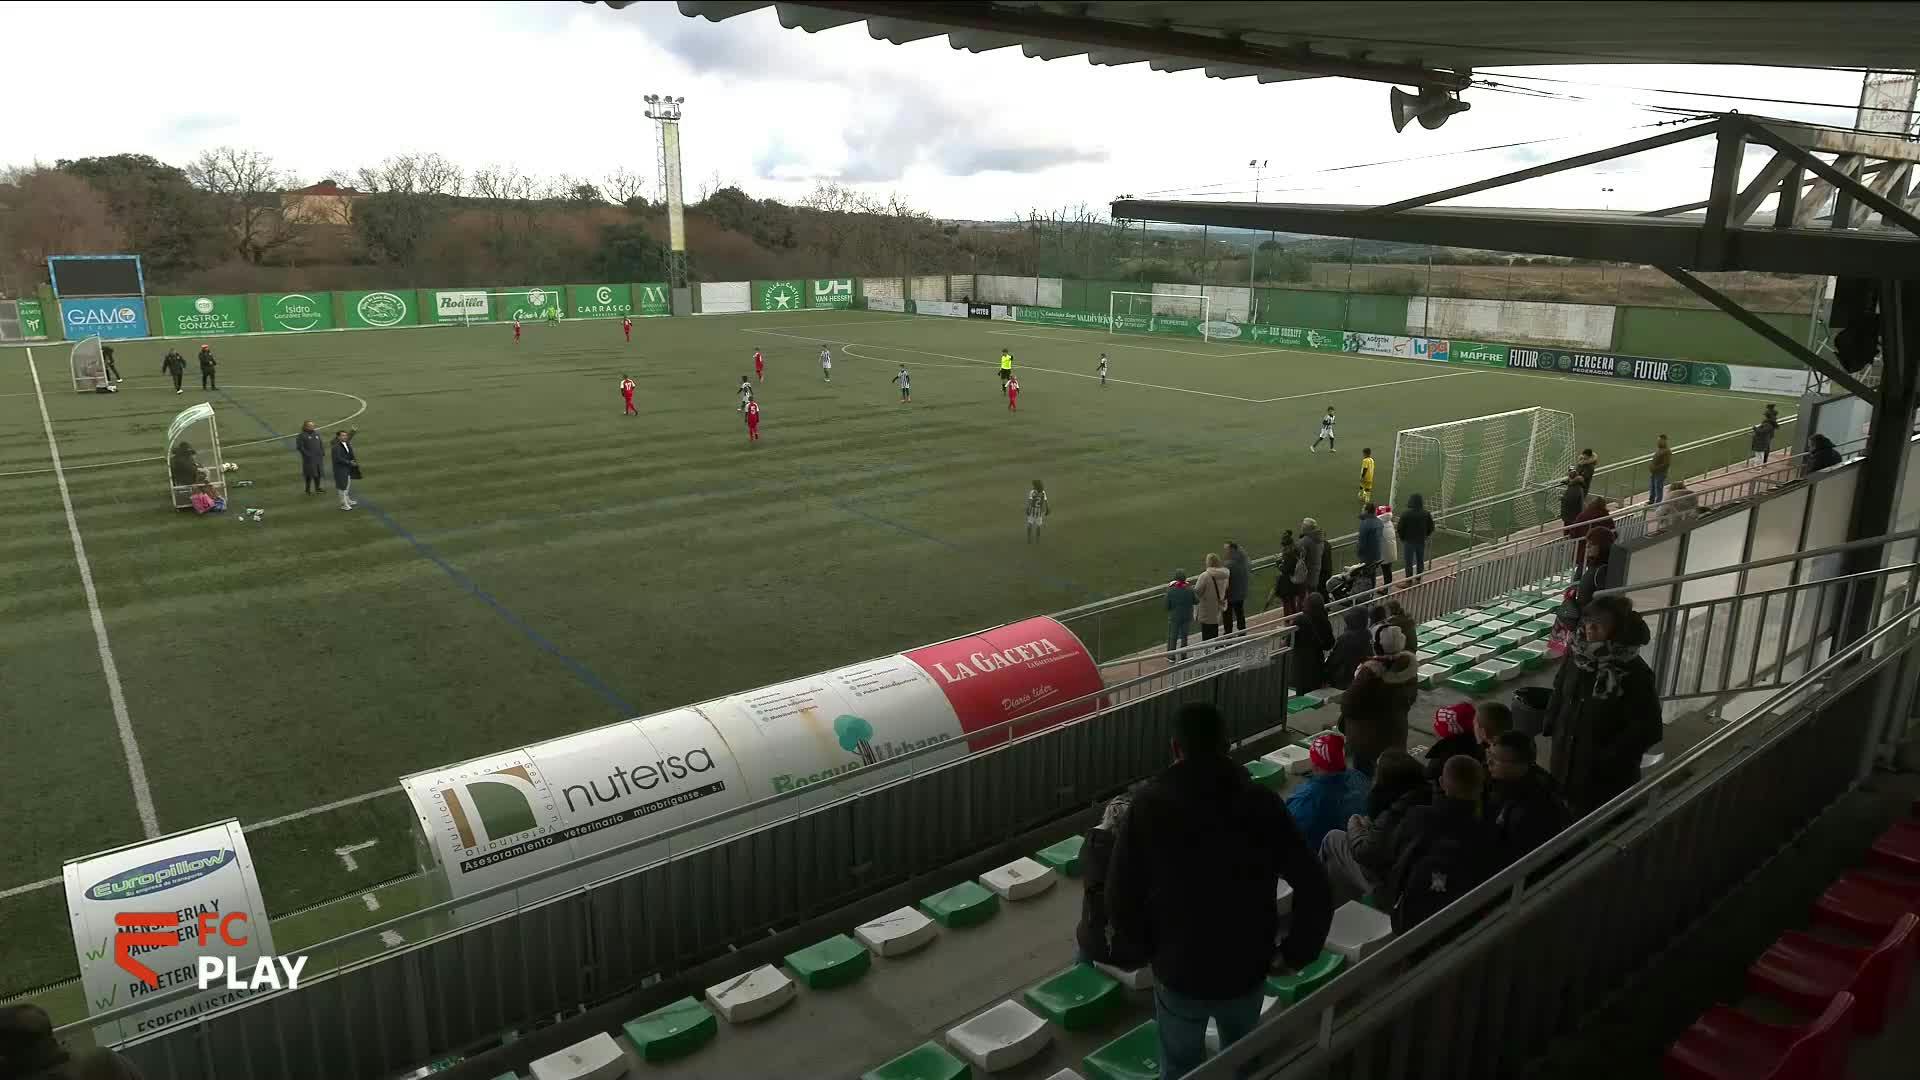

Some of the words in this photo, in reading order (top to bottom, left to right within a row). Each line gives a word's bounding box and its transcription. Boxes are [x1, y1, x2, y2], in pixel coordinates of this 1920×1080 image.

[285, 305, 311, 313] Isidro
[578, 305, 631, 313] CARRASCO
[177, 314, 220, 323] CASTRO
[221, 313, 229, 321] Y
[1414, 338, 1449, 360] lupa
[1460, 351, 1504, 362] MAPFRE
[1574, 354, 1615, 370] TERCERA
[932, 662, 978, 684] LA
[970, 638, 1063, 673] GACETA
[562, 748, 715, 812] nutersa
[464, 837, 553, 872] Asesoramiento
[563, 814, 624, 838] veterinario
[93, 847, 226, 898] Europillow
[163, 879, 171, 887] de
[211, 899, 219, 911] Y
